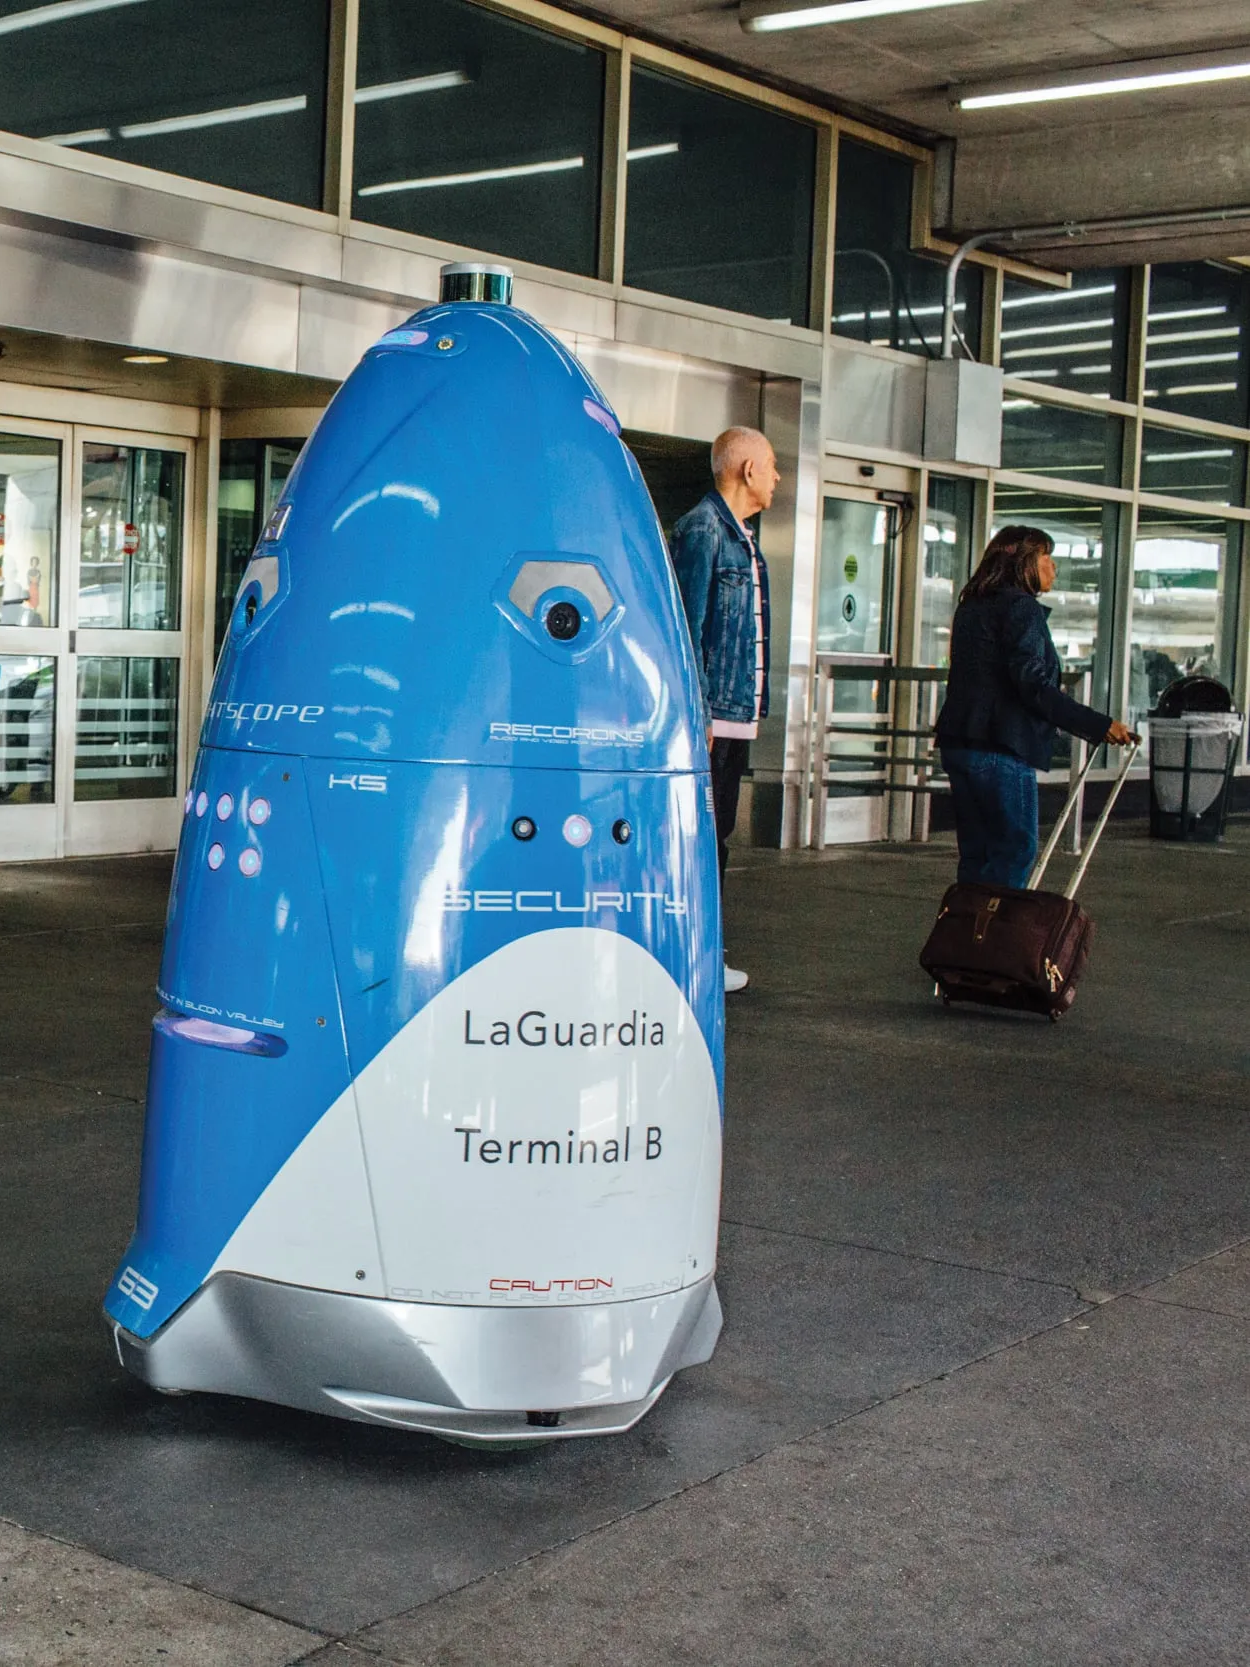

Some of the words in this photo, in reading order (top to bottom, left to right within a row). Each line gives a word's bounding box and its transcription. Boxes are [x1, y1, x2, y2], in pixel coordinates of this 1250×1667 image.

[489, 722, 645, 743] RECORDING
[328, 773, 387, 792] K5
[440, 890, 688, 915] SECURITY
[226, 1009, 285, 1029] VALLEY
[464, 1009, 665, 1047] LaGuardia
[454, 1126, 631, 1164] Terminal
[645, 1126, 663, 1161] B
[117, 1266, 159, 1310] 63
[390, 1286, 423, 1299] DO
[432, 1289, 482, 1300] NOT
[489, 1277, 614, 1292] CAUTION
